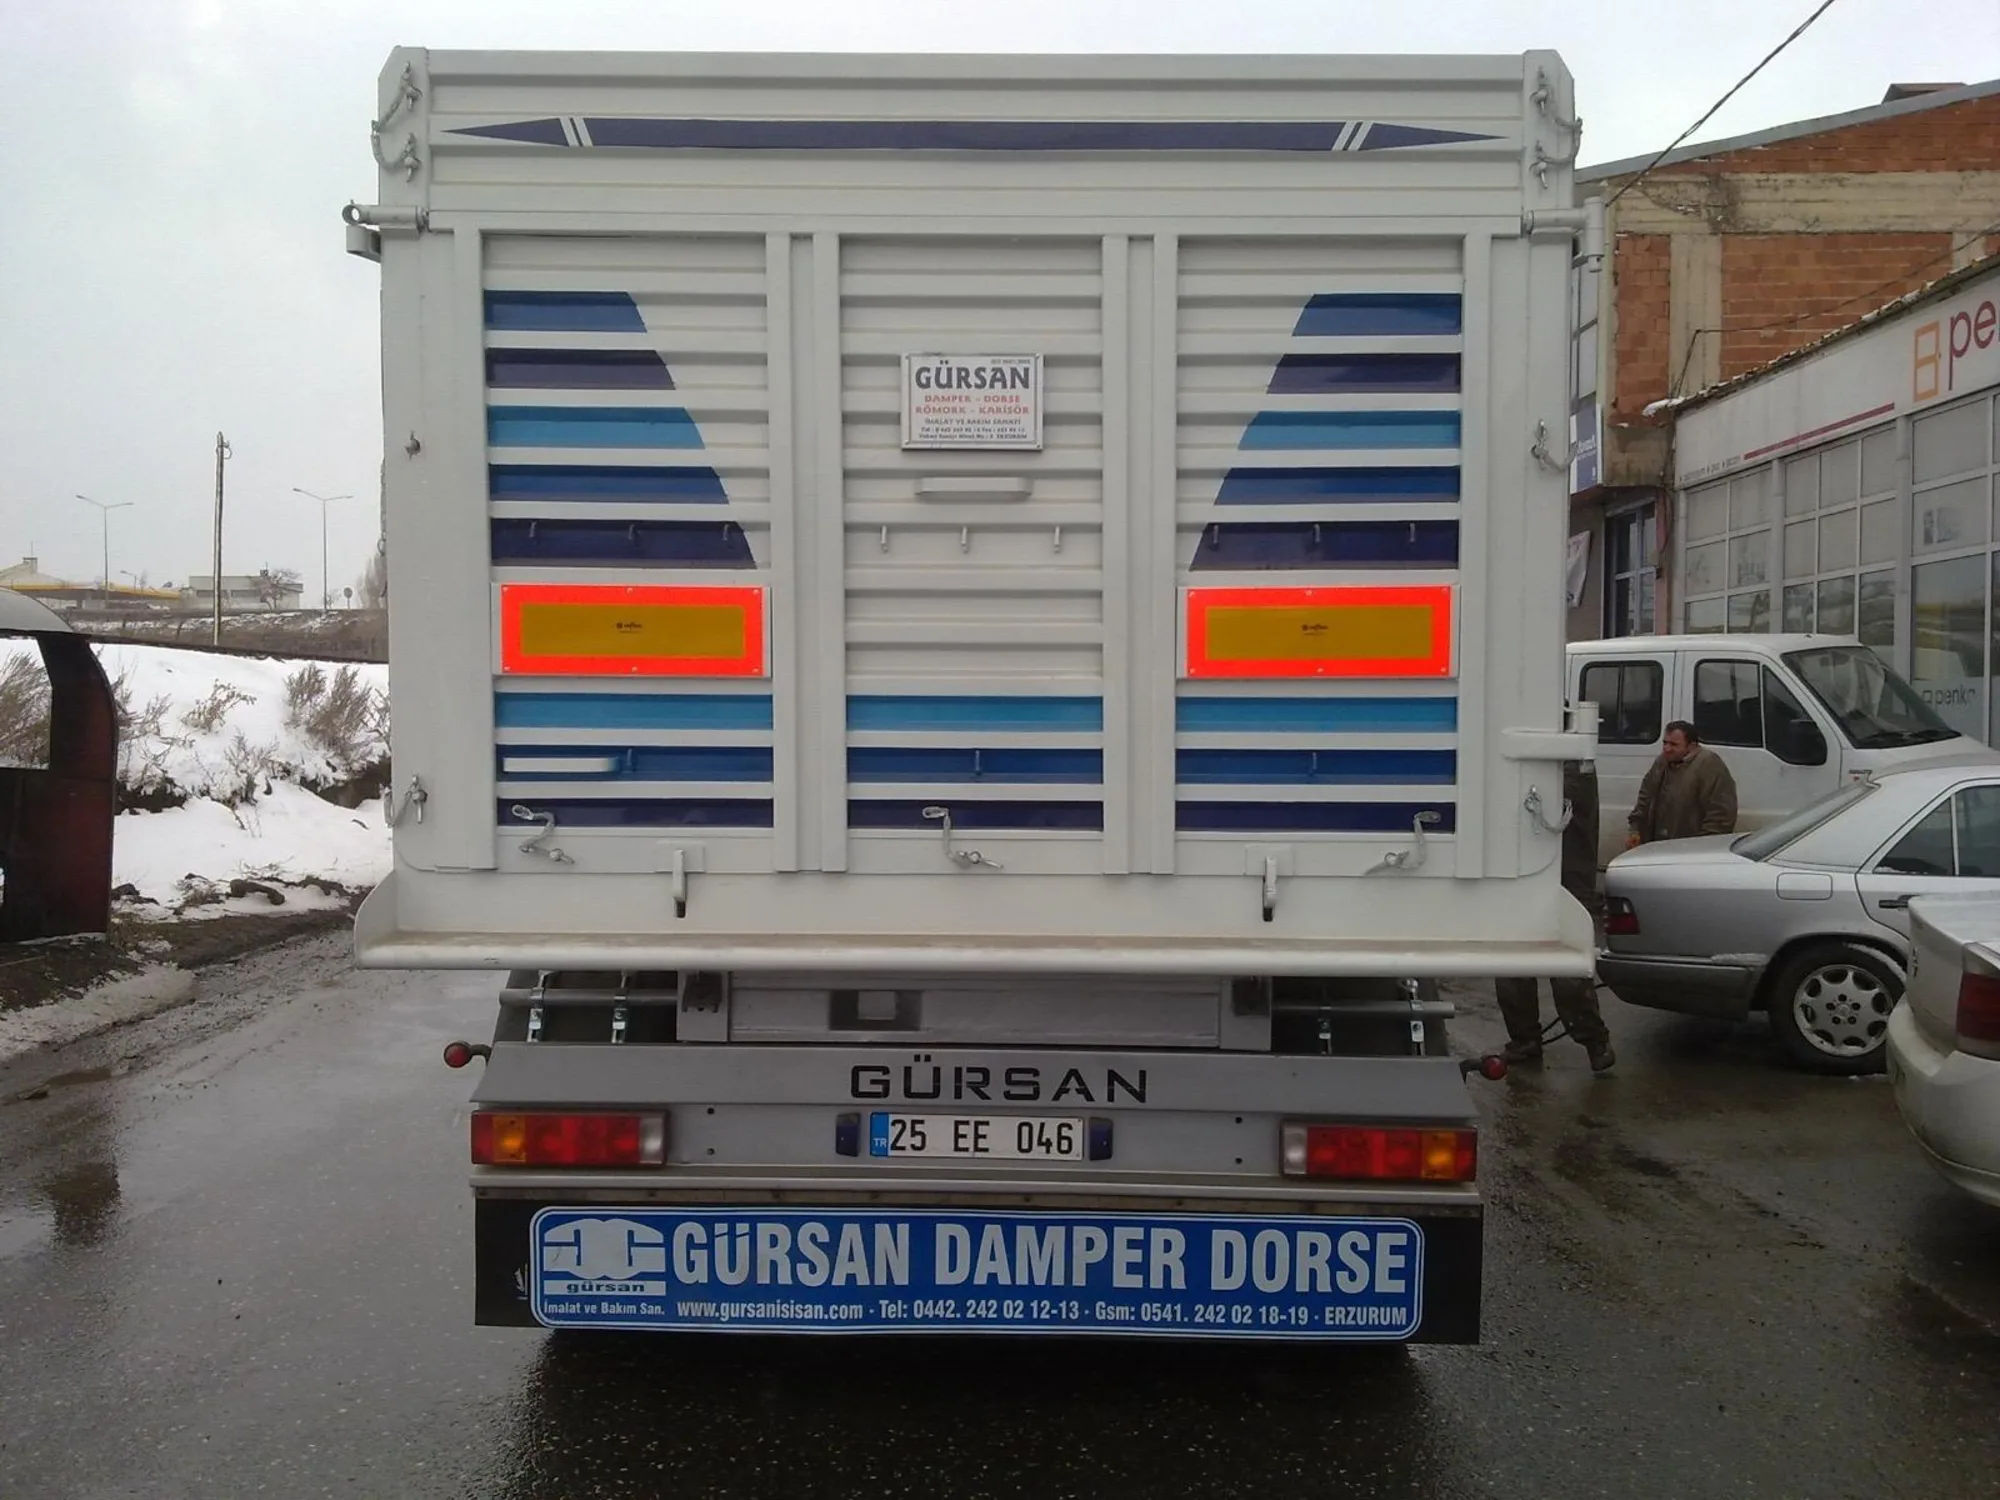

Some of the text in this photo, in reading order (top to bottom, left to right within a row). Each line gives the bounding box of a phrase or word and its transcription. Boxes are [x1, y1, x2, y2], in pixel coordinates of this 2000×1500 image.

[1948, 300, 2000, 391] pe
[915, 360, 1030, 389] GÜRSAN
[924, 395, 1021, 403] DAMPER DORSE
[851, 1054, 1147, 1103] GÜRSAN
[873, 1119, 1073, 1154] TR 25 EE 046
[673, 1222, 1408, 1295] GÜRSAN DAMPER DORSE
[566, 1281, 646, 1294] gürsan
[544, 1299, 665, 1316] İmalat ve Bakım San.
[677, 1299, 1407, 1326] www.gursanisisan.com Tel: 0442. 242 02 12-13 Gsm: 0541. 242 02 18-19 ERZURUM
